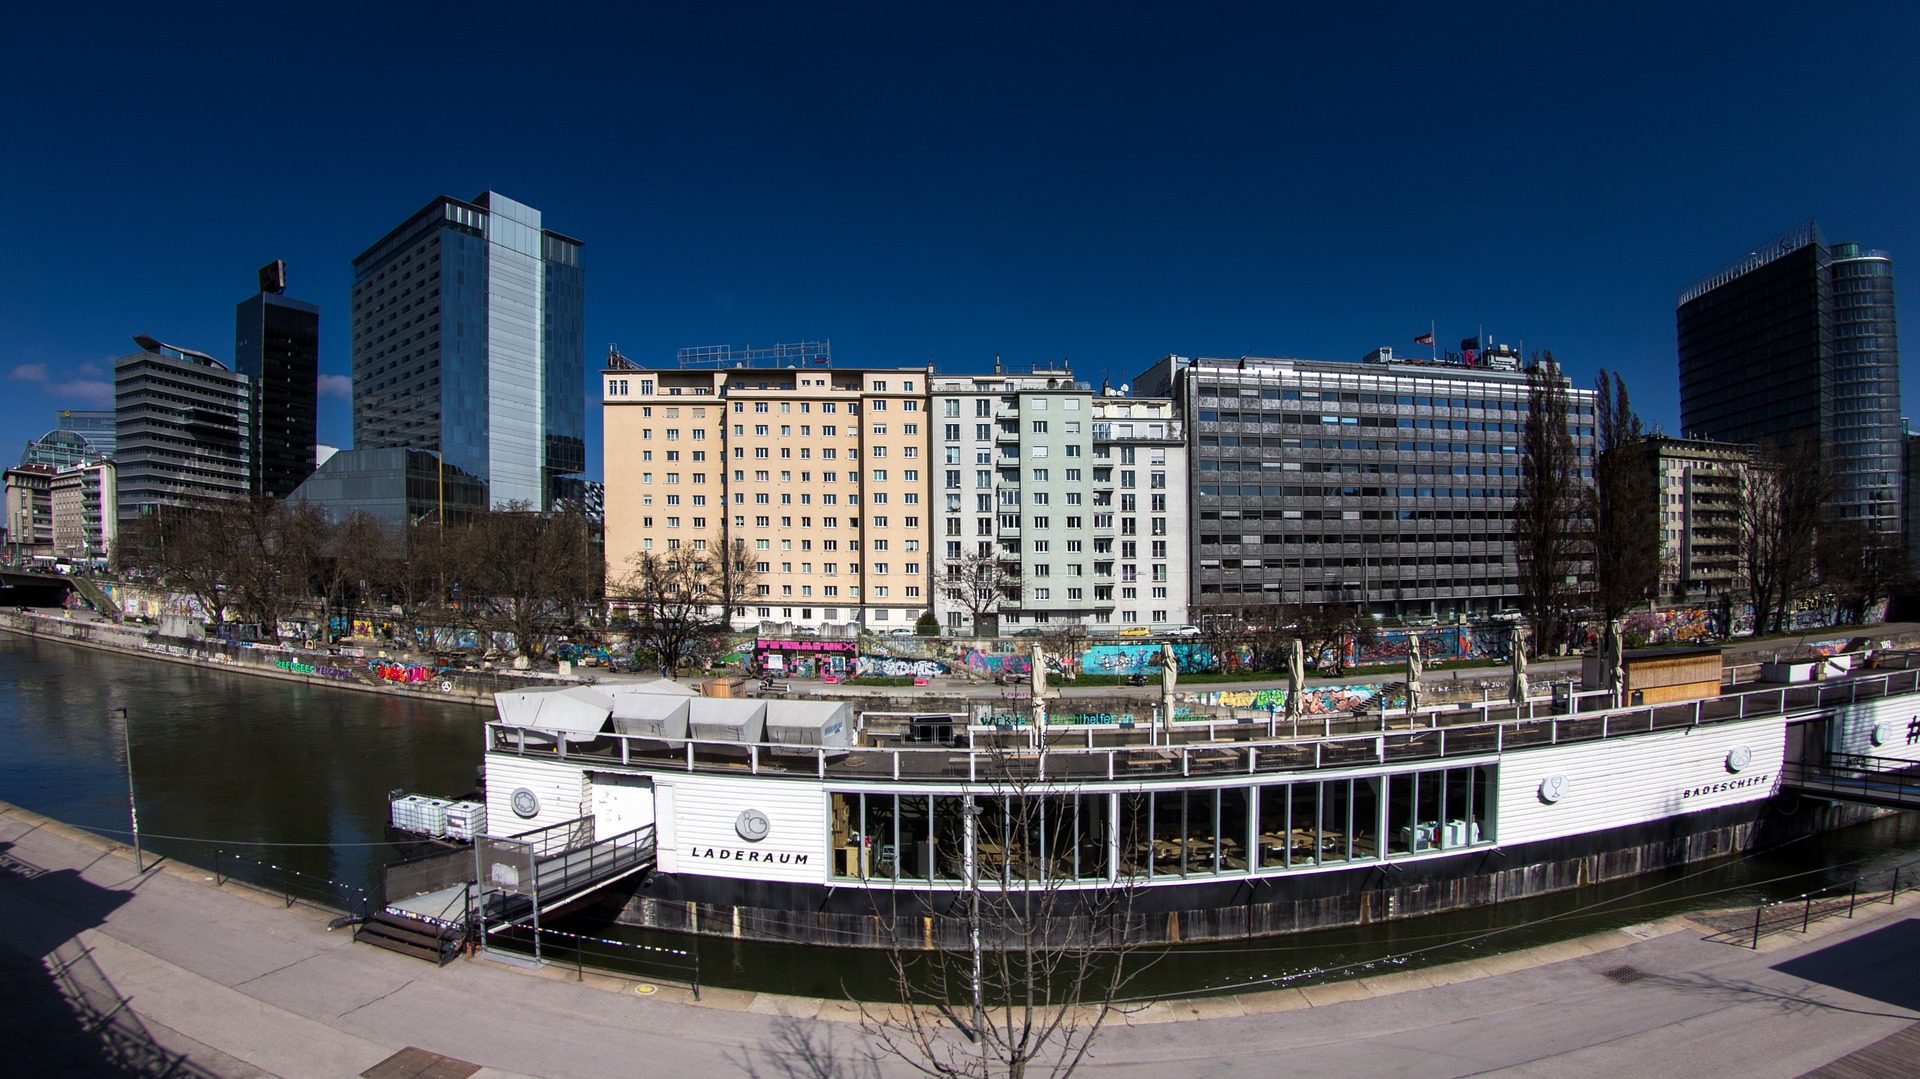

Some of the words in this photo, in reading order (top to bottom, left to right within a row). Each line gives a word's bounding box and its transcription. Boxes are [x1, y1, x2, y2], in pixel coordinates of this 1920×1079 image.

[275, 660, 315, 675] REFUGEES
[315, 664, 350, 679] WELCOME
[1683, 775, 1768, 798] BADESCHIFF
[692, 847, 808, 865] LADERAUM
